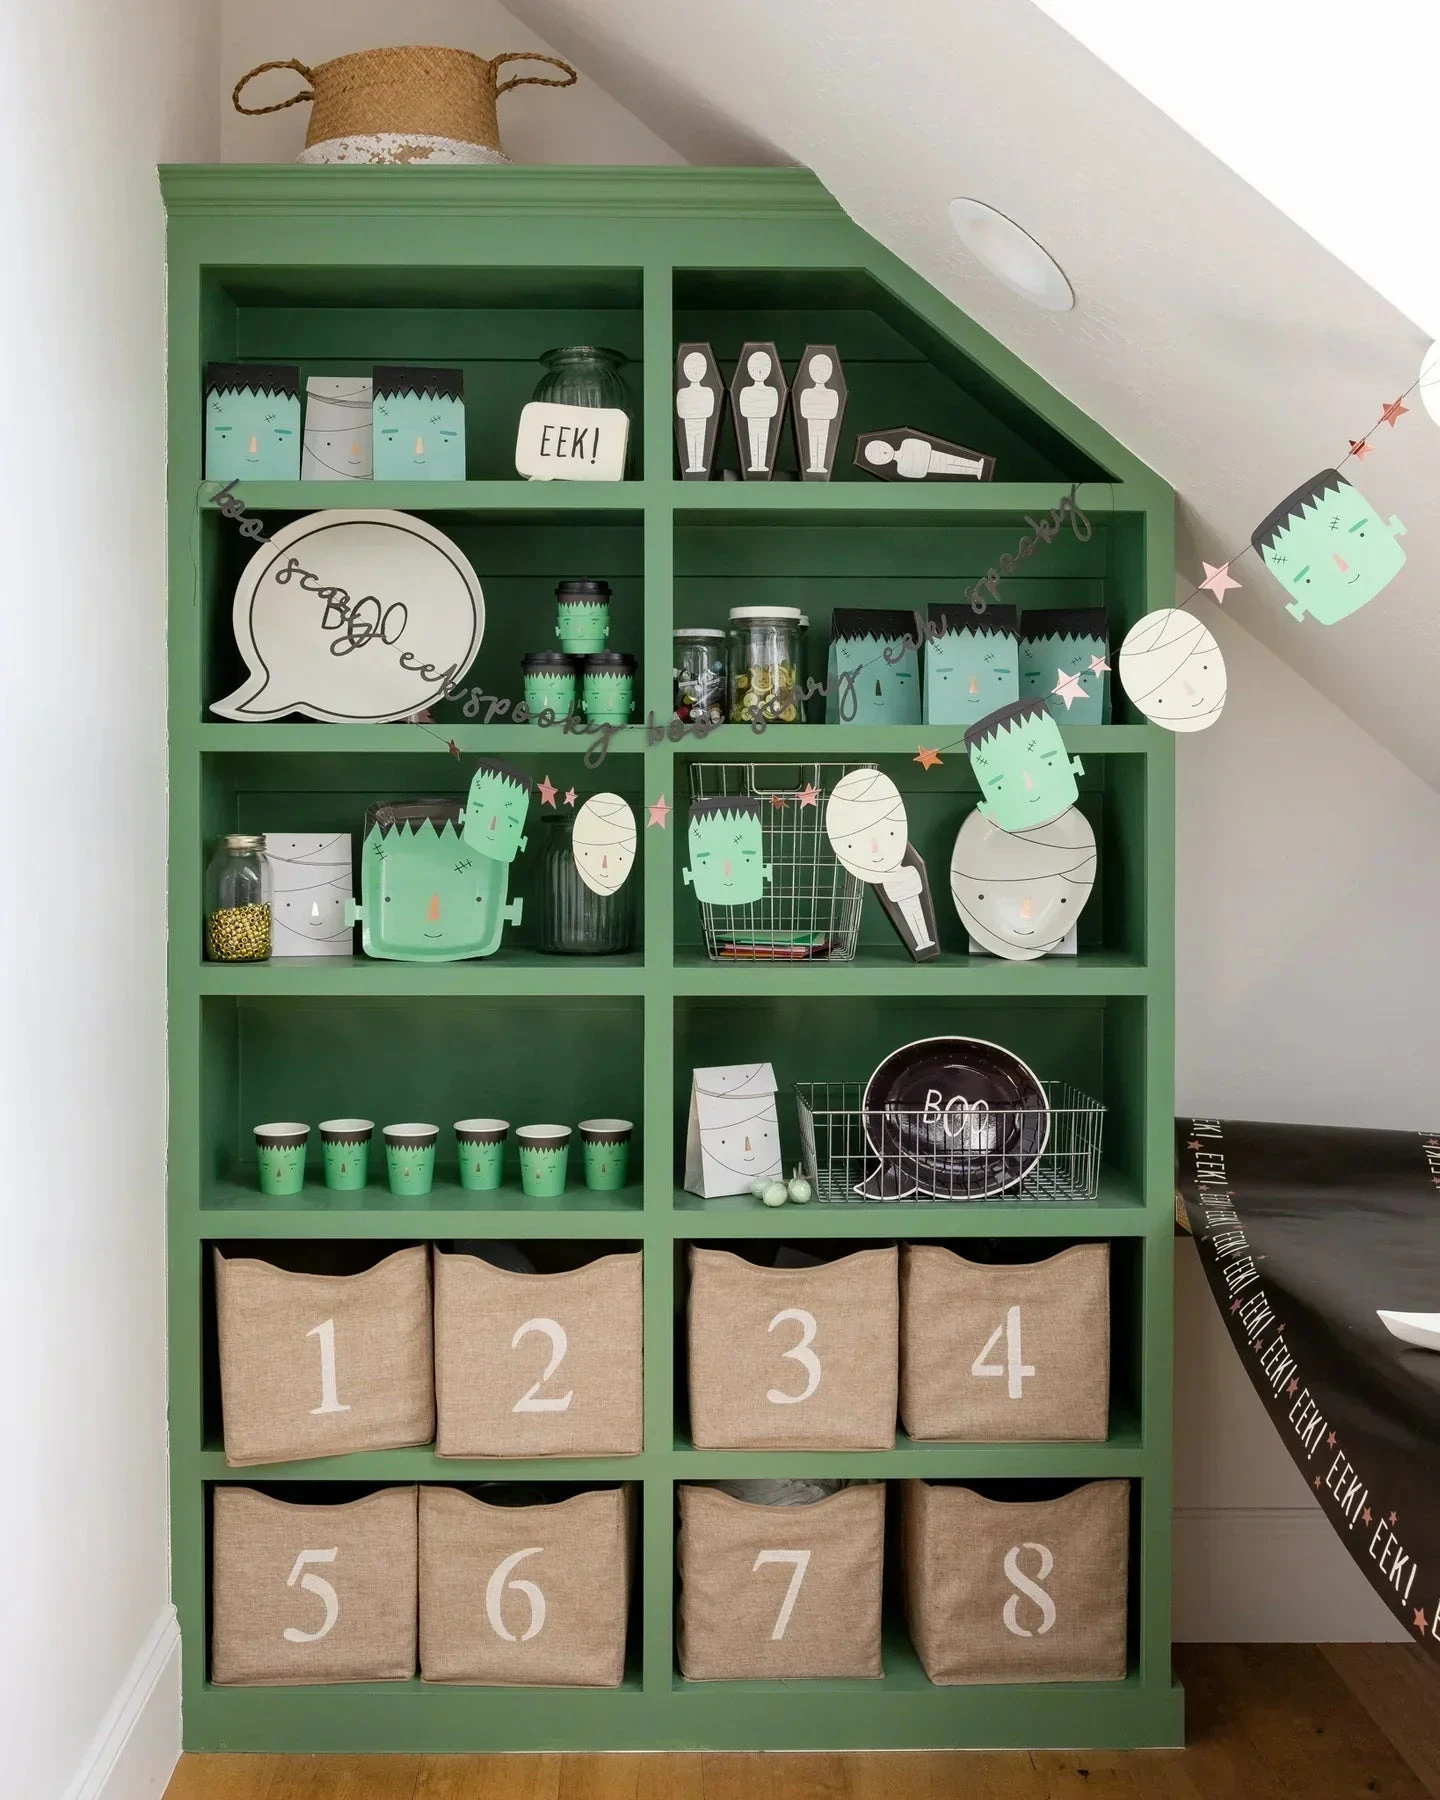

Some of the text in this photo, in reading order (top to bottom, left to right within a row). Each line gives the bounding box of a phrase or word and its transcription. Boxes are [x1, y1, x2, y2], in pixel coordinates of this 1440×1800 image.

[540, 424, 600, 464] EEK!
[208, 478, 271, 543] boo
[399, 651, 467, 701] eek
[462, 686, 628, 770] spooky
[647, 710, 725, 748] boo
[750, 663, 863, 735] scary
[321, 586, 408, 649] BOO
[922, 1088, 990, 1138] BOO
[1193, 1152, 1229, 1185] EEK!
[1205, 1210, 1242, 1229] EEK!
[1212, 1230, 1250, 1262] EEK!
[1223, 1256, 1260, 1300] EEK!
[1239, 1290, 1276, 1345] EEK!
[306, 1318, 352, 1415] 1
[511, 1317, 575, 1413] 2
[766, 1307, 822, 1404] 3
[971, 1305, 1036, 1400] 4
[1259, 1335, 1298, 1399] EEK!
[1288, 1387, 1328, 1460] EEK!
[1325, 1450, 1369, 1530] EEK!
[283, 1546, 340, 1643] 5
[486, 1547, 547, 1642] 6
[752, 1549, 811, 1641] 7
[1002, 1542, 1057, 1637] 8
[1368, 1518, 1417, 1607] EEK!
